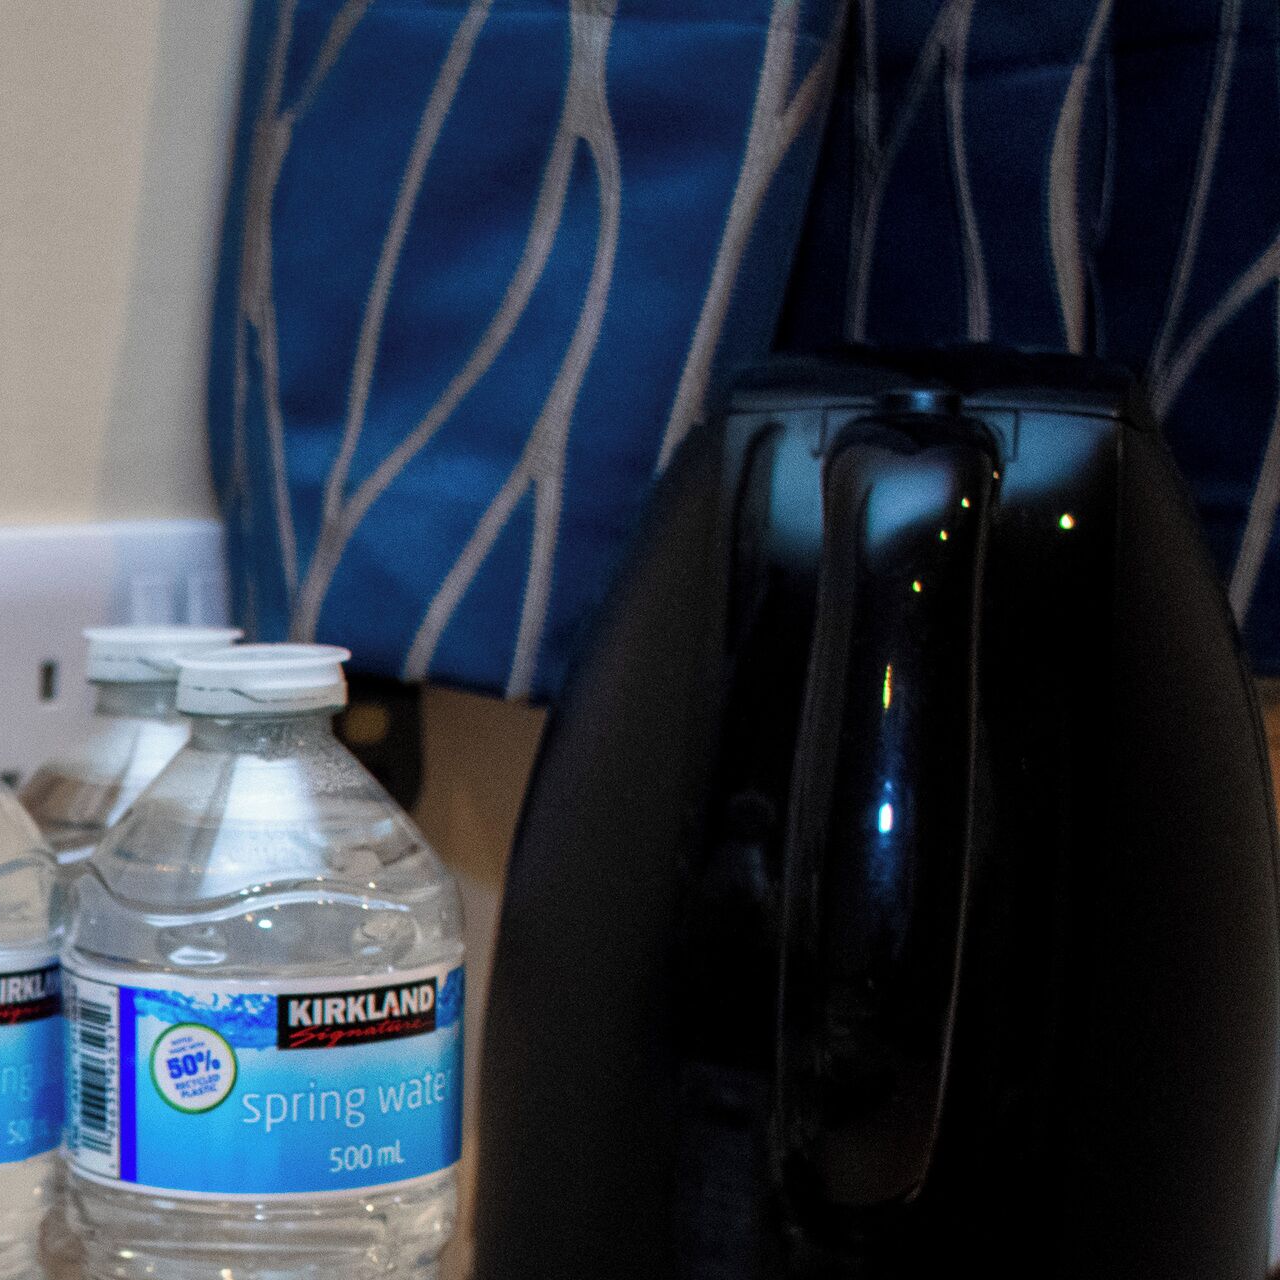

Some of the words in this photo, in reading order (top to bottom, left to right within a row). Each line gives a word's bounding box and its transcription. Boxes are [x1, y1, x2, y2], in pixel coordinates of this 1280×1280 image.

[287, 984, 436, 1027] KIRKLAND
[289, 1017, 434, 1049] Signature
[165, 1049, 221, 1078] 50%
[242, 1081, 366, 1132] spring
[328, 1143, 373, 1173] 500
